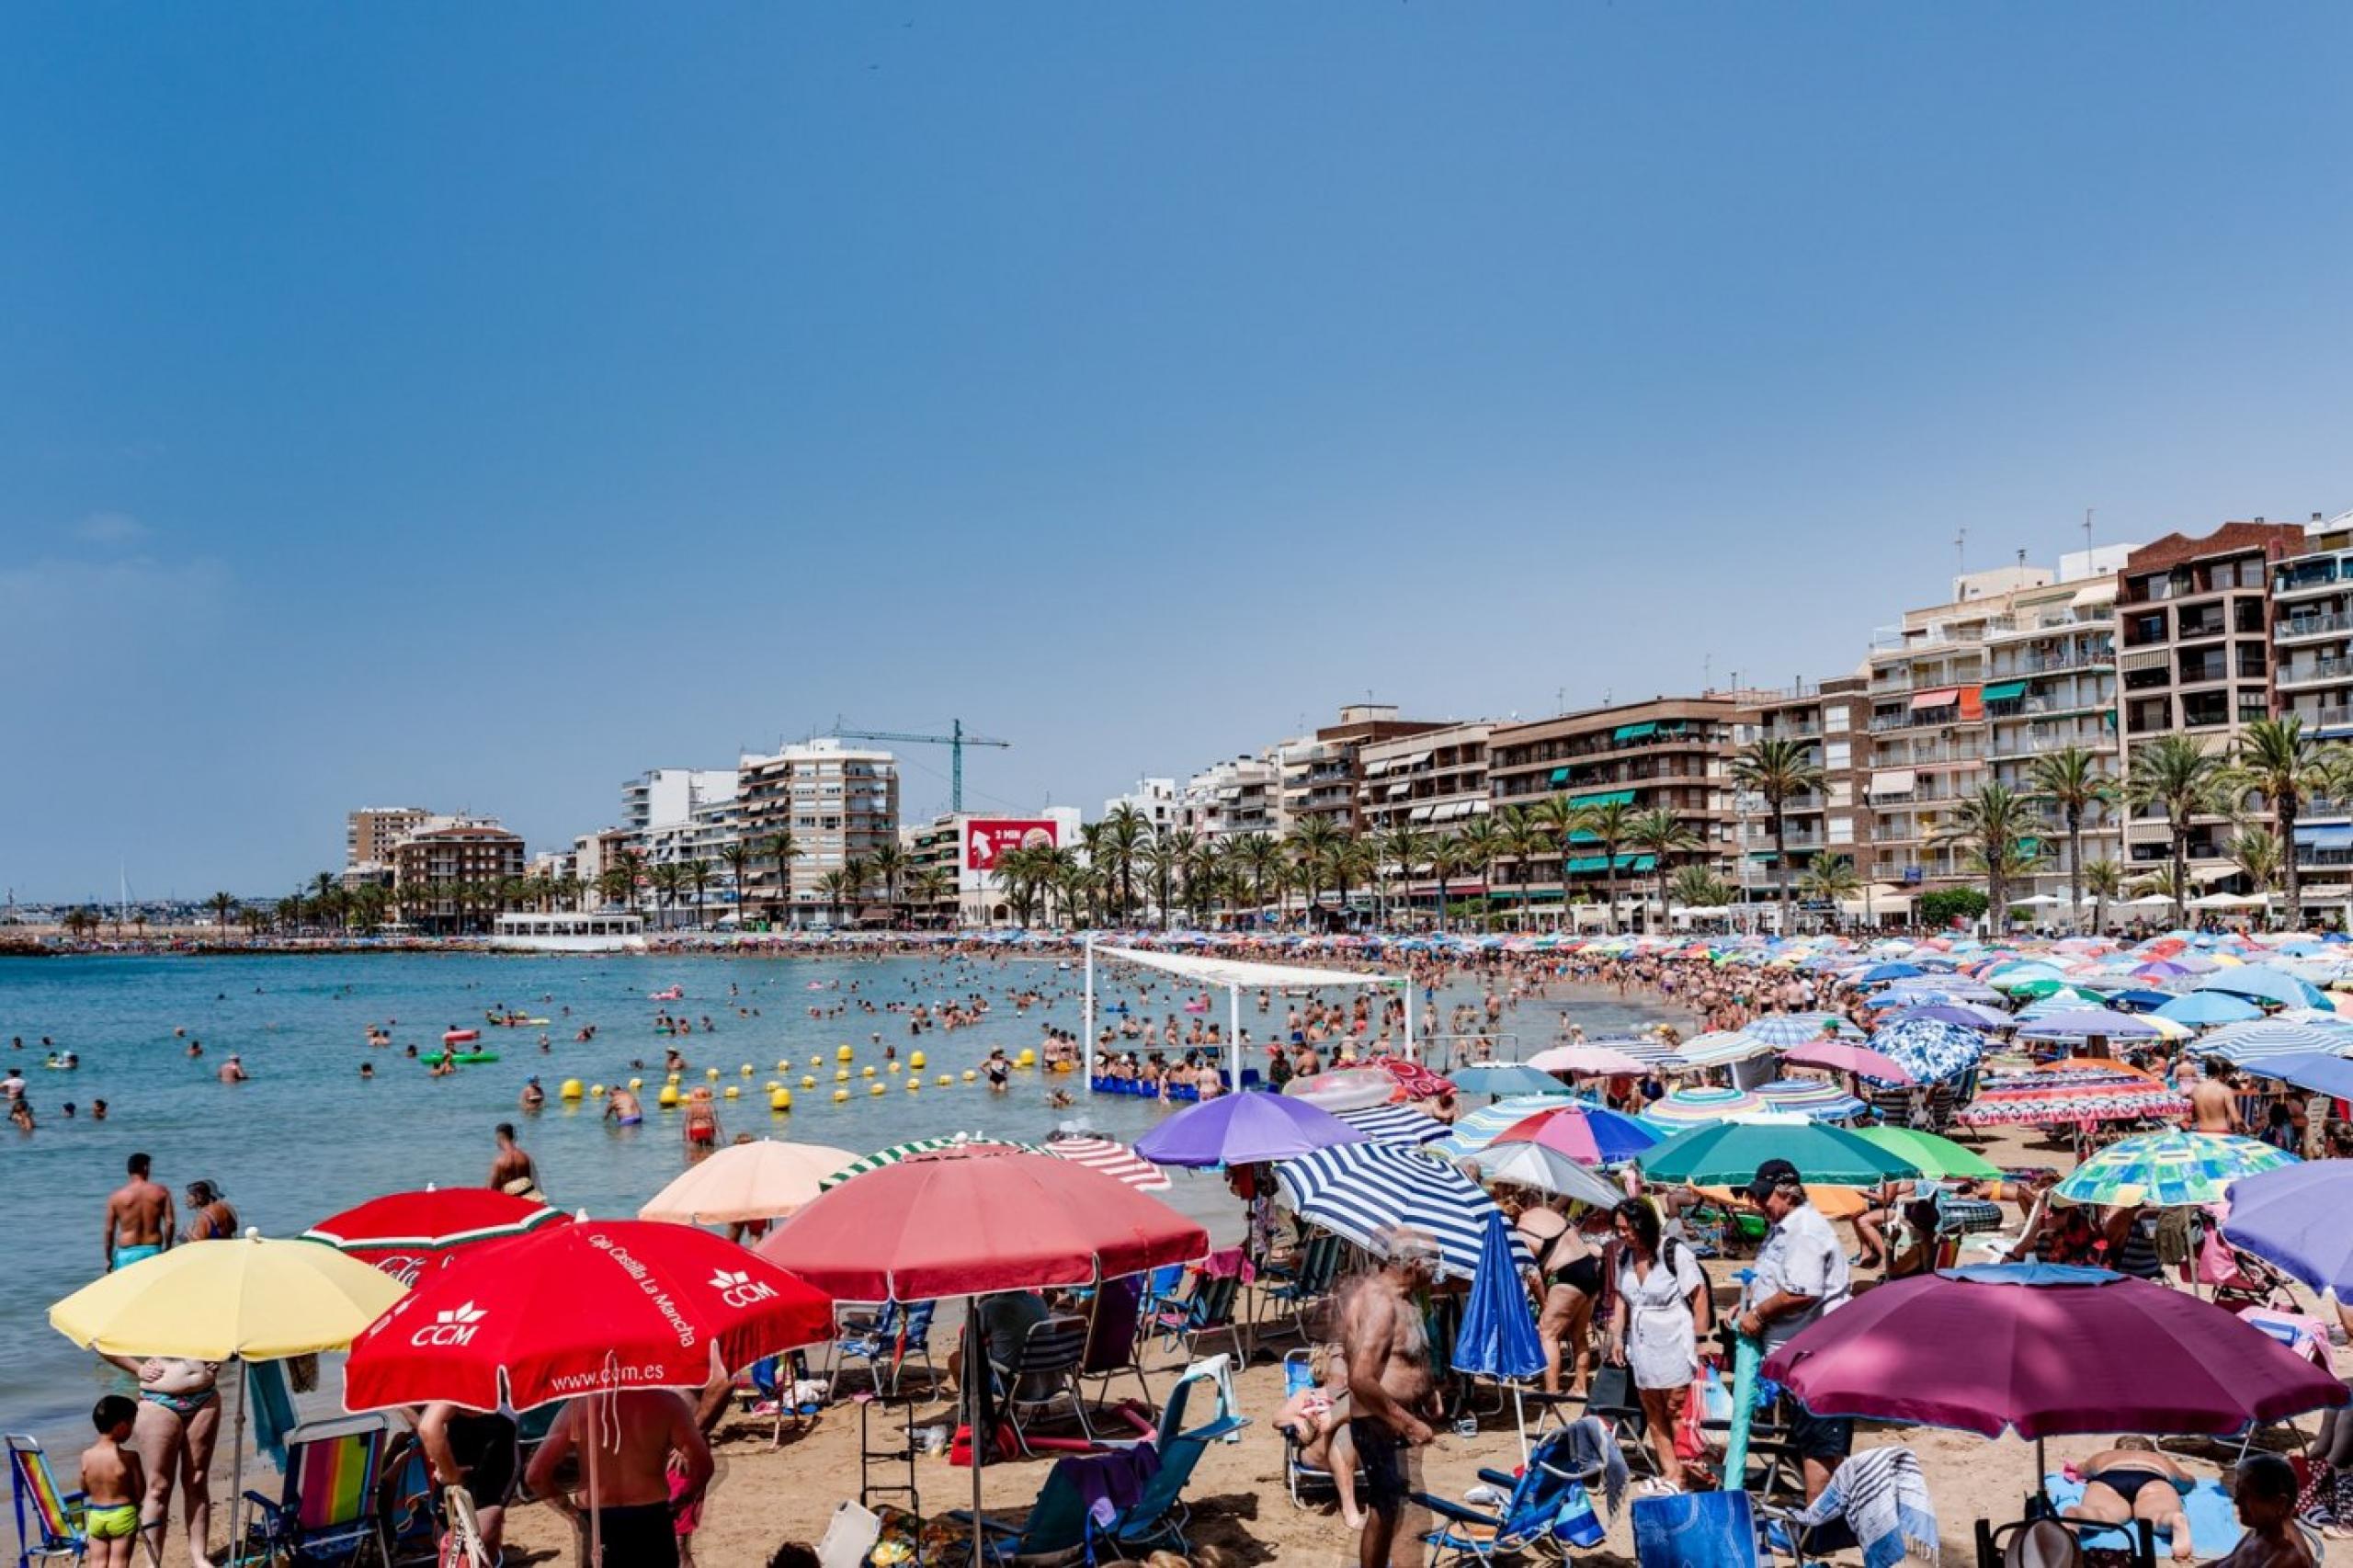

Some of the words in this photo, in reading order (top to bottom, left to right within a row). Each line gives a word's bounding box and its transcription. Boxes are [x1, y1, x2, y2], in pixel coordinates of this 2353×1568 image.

[588, 1234, 613, 1249] Caja
[609, 1246, 647, 1279] Castilla
[640, 1278, 659, 1294] La
[653, 1293, 695, 1347] Mancha
[722, 1281, 779, 1308] CCM
[411, 1324, 479, 1346] CCM
[551, 1364, 665, 1392] www.ccm.es
